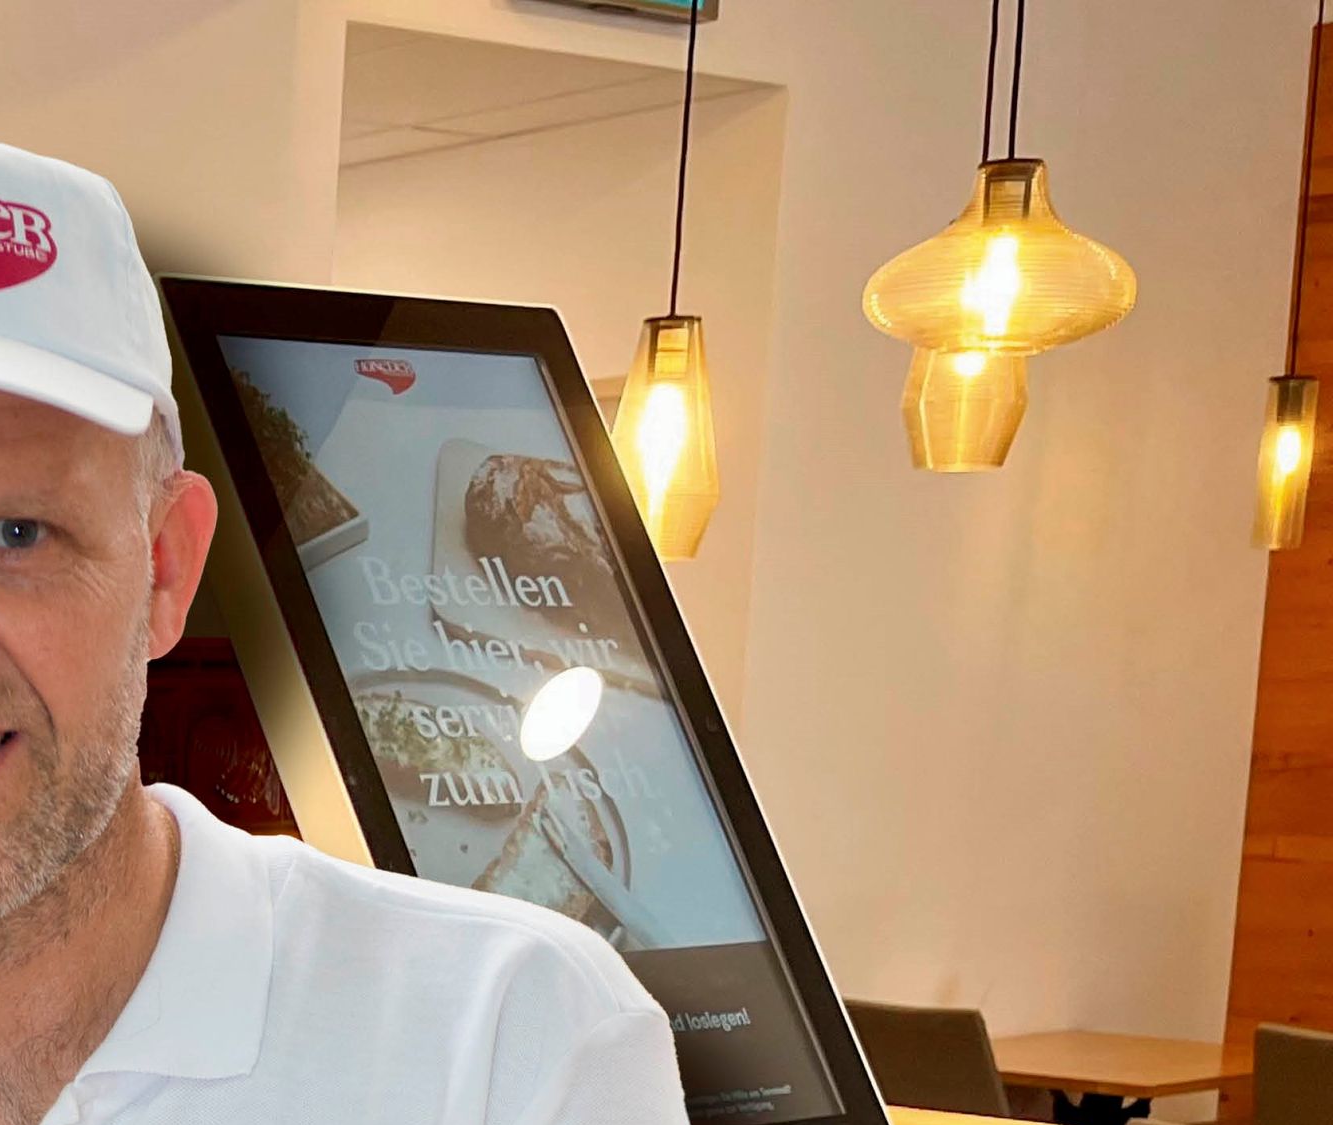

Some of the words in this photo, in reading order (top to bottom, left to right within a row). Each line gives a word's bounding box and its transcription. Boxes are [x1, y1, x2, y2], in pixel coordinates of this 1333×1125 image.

[356, 556, 573, 607] Bestellen
[353, 621, 431, 672] Sie
[433, 620, 545, 676] hier,
[547, 622, 619, 669] wir
[420, 771, 527, 807] zum
[685, 1006, 752, 1032] loslegen!
